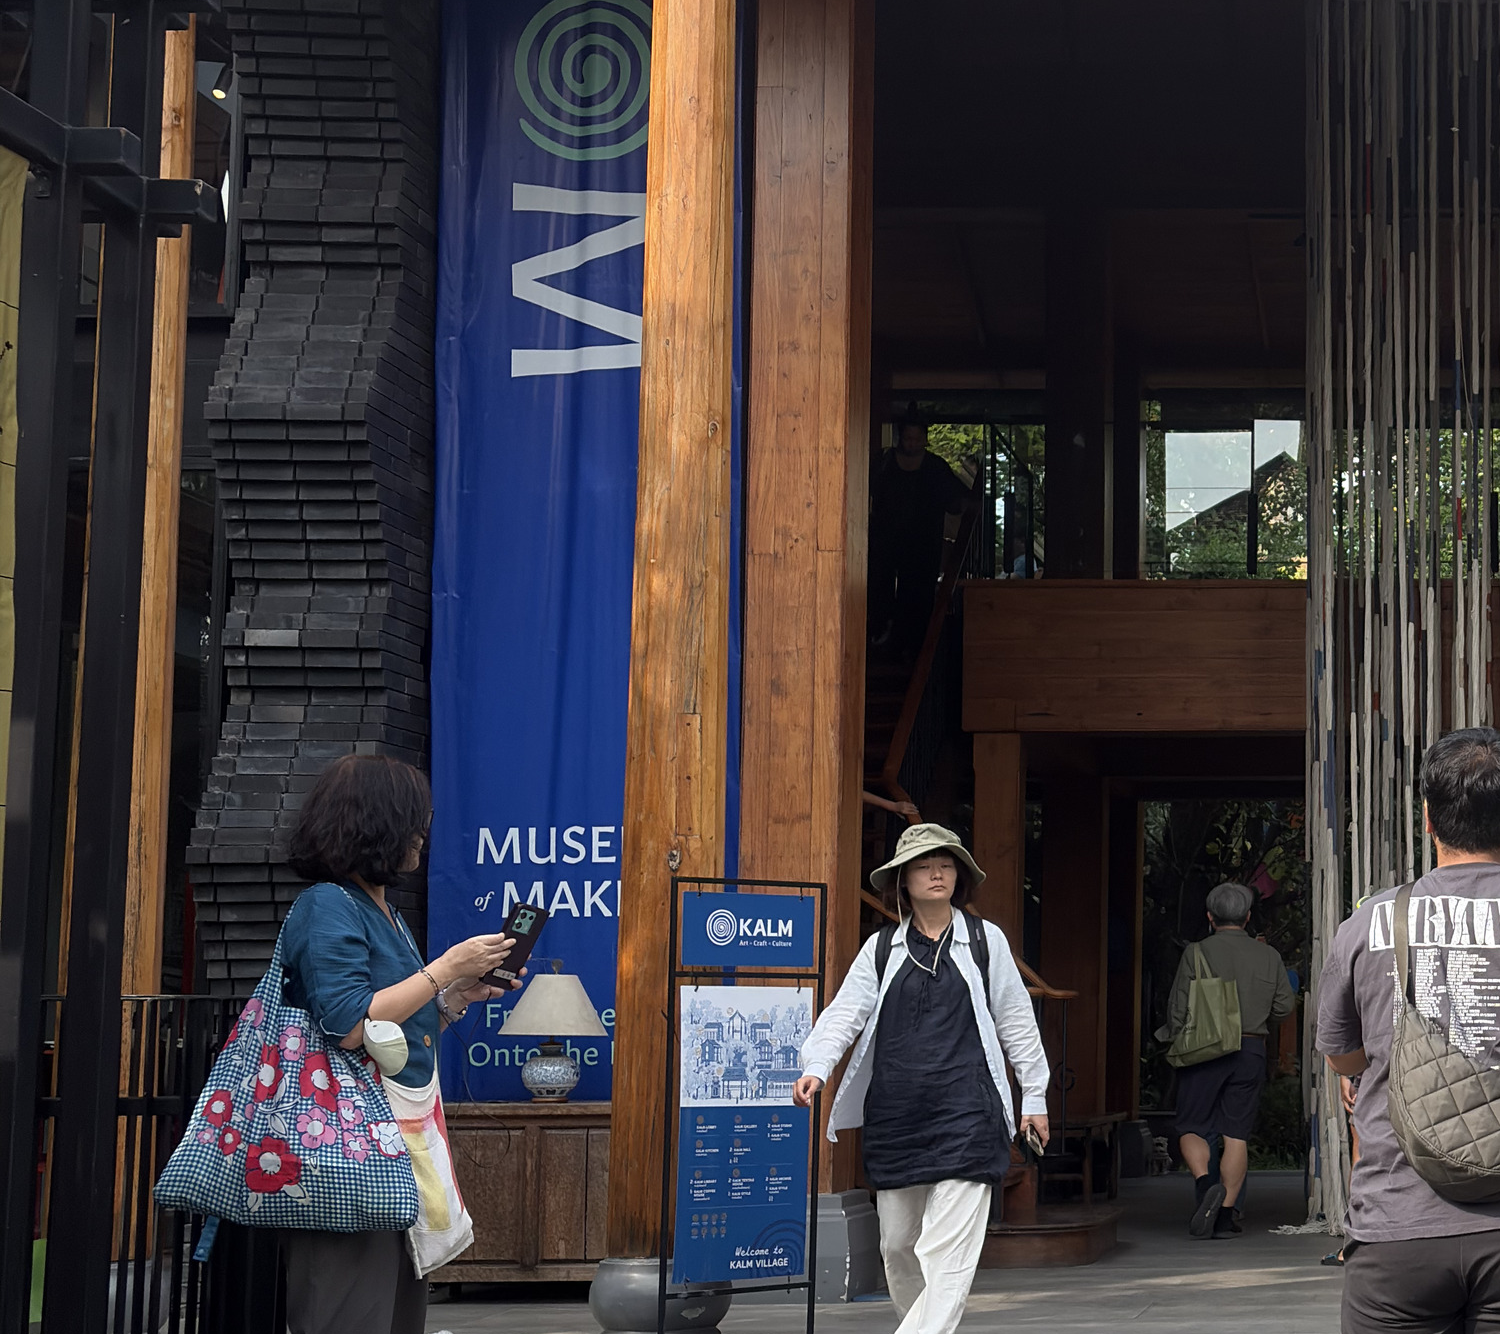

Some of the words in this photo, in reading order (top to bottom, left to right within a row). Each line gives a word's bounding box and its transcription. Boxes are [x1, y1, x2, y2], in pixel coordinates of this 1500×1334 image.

[476, 825, 624, 865] MUSE
[474, 891, 494, 912] of
[502, 880, 621, 918] MAK
[739, 918, 793, 937] KALM
[566, 1039, 598, 1065] he
[735, 1246, 769, 1257] Welcome
[773, 1245, 783, 1255] to
[729, 1259, 753, 1270] KALM
[756, 1257, 789, 1268] VILLAGE
